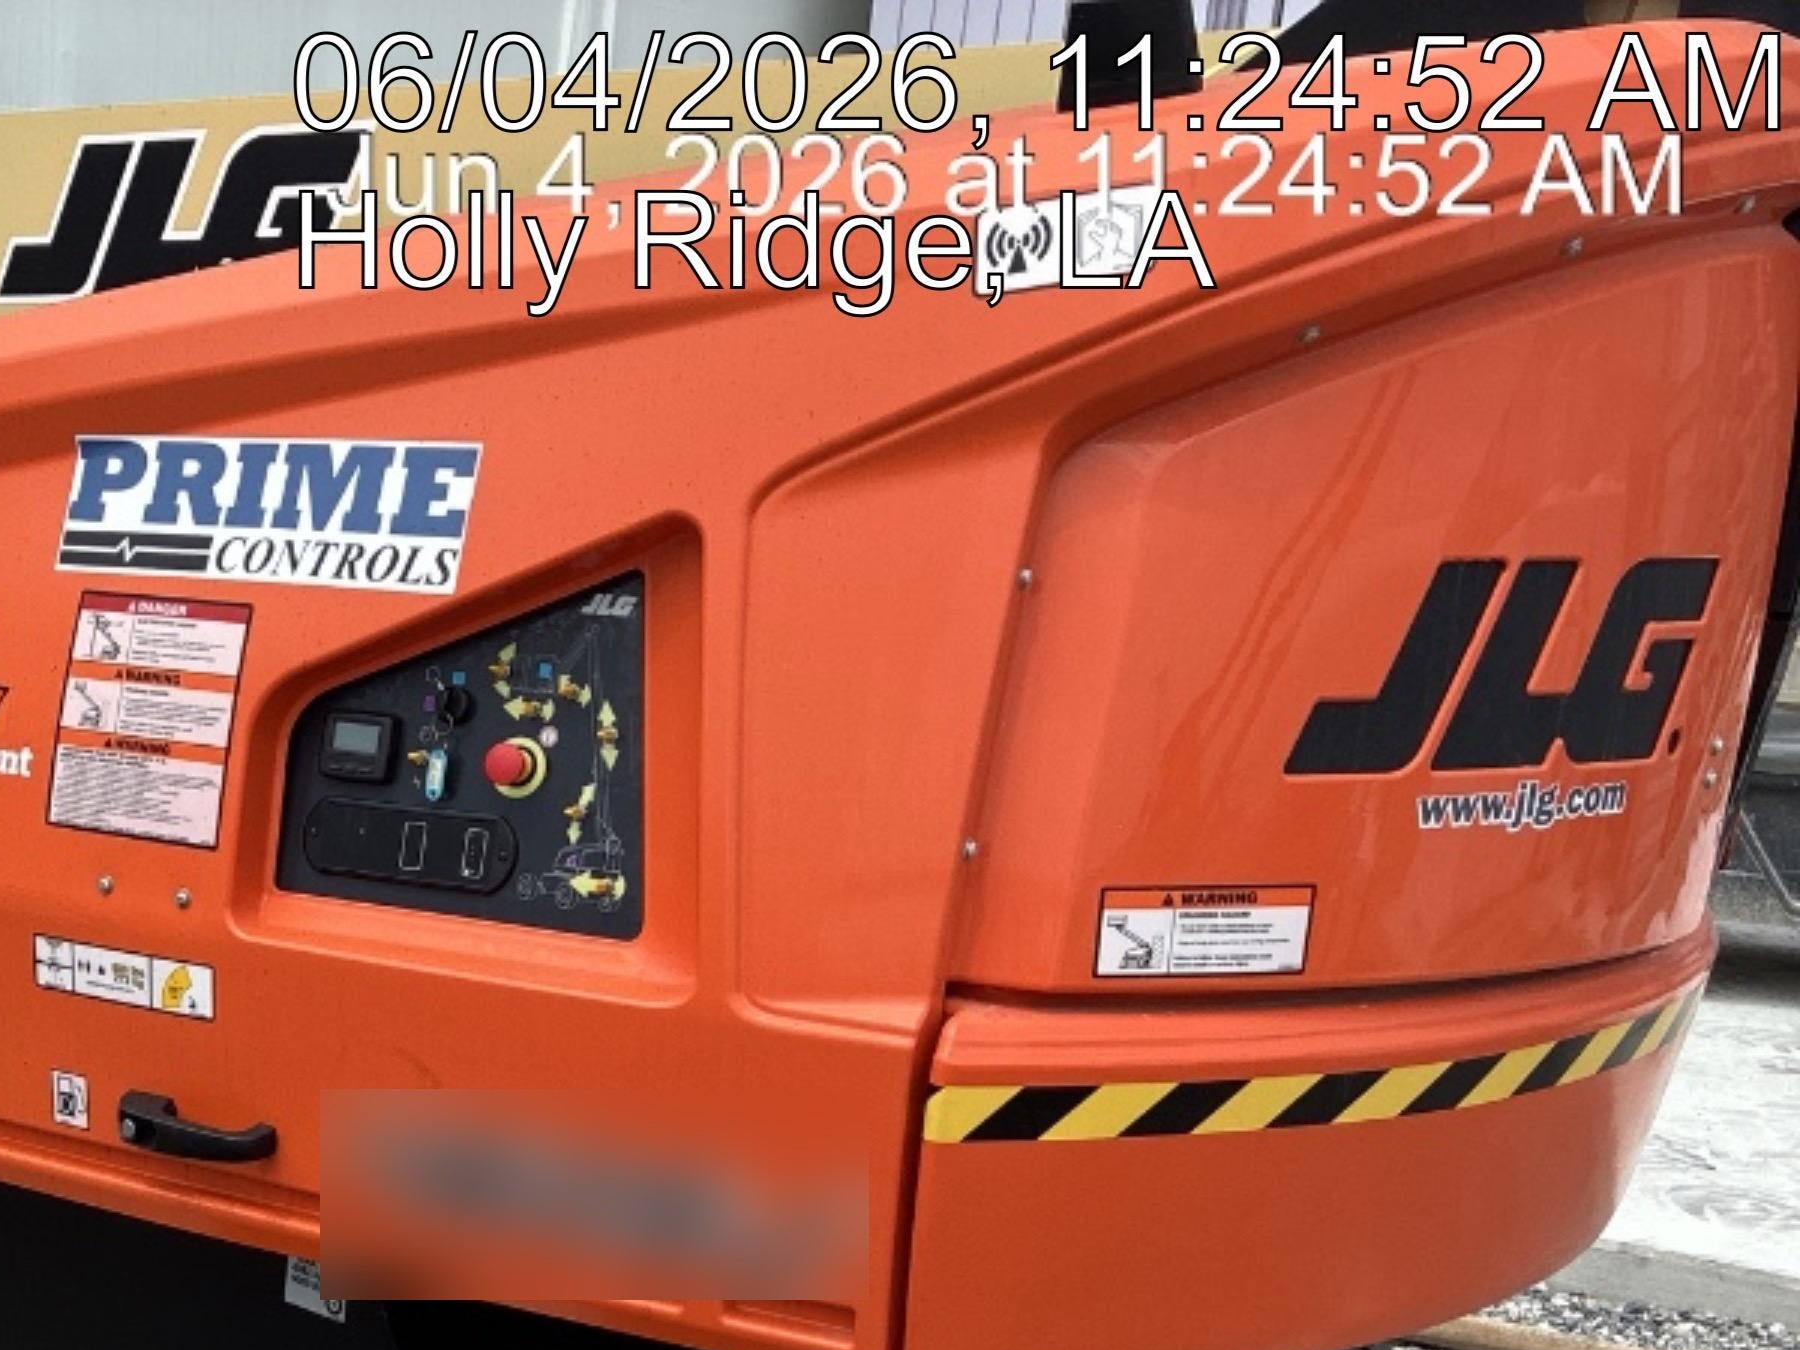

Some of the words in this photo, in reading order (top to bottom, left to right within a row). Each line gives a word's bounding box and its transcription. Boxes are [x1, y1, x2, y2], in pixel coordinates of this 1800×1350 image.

[68, 439, 480, 538] PRIME
[214, 536, 459, 586] CONTROLS
[581, 593, 638, 617] JLG
[1283, 557, 1721, 775] JLG
[1418, 779, 1627, 832] www.jlg.com
[1181, 890, 1258, 906] WARNING
